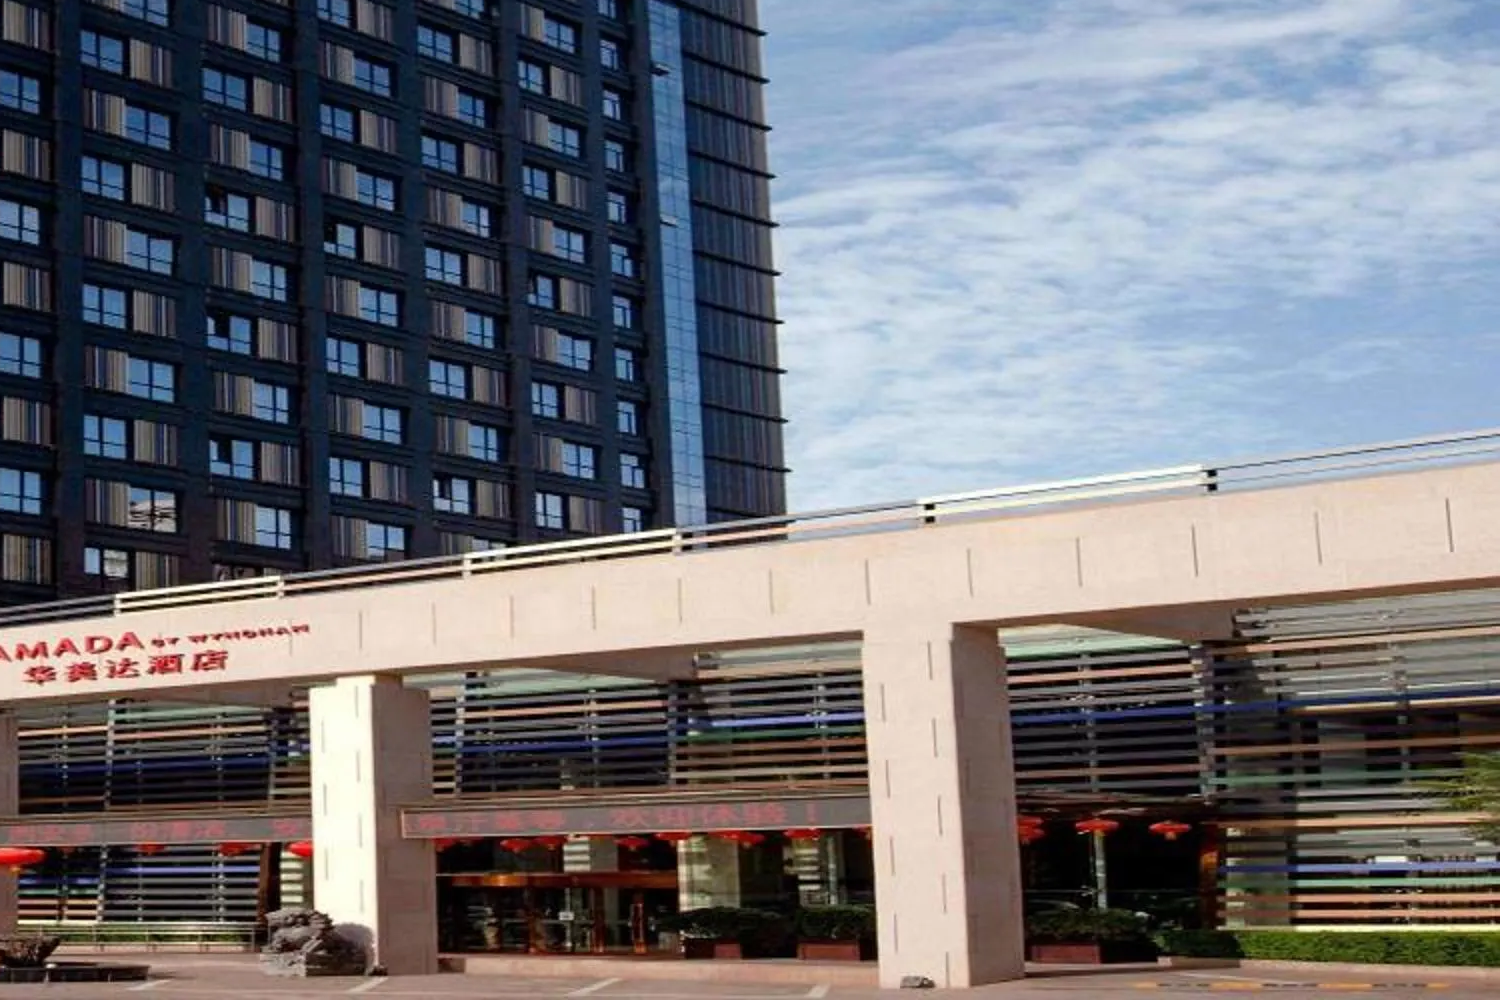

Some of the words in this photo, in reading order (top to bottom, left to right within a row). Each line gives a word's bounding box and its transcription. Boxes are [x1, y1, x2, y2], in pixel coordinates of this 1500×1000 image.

[22, 649, 229, 687] 华美达酒店
